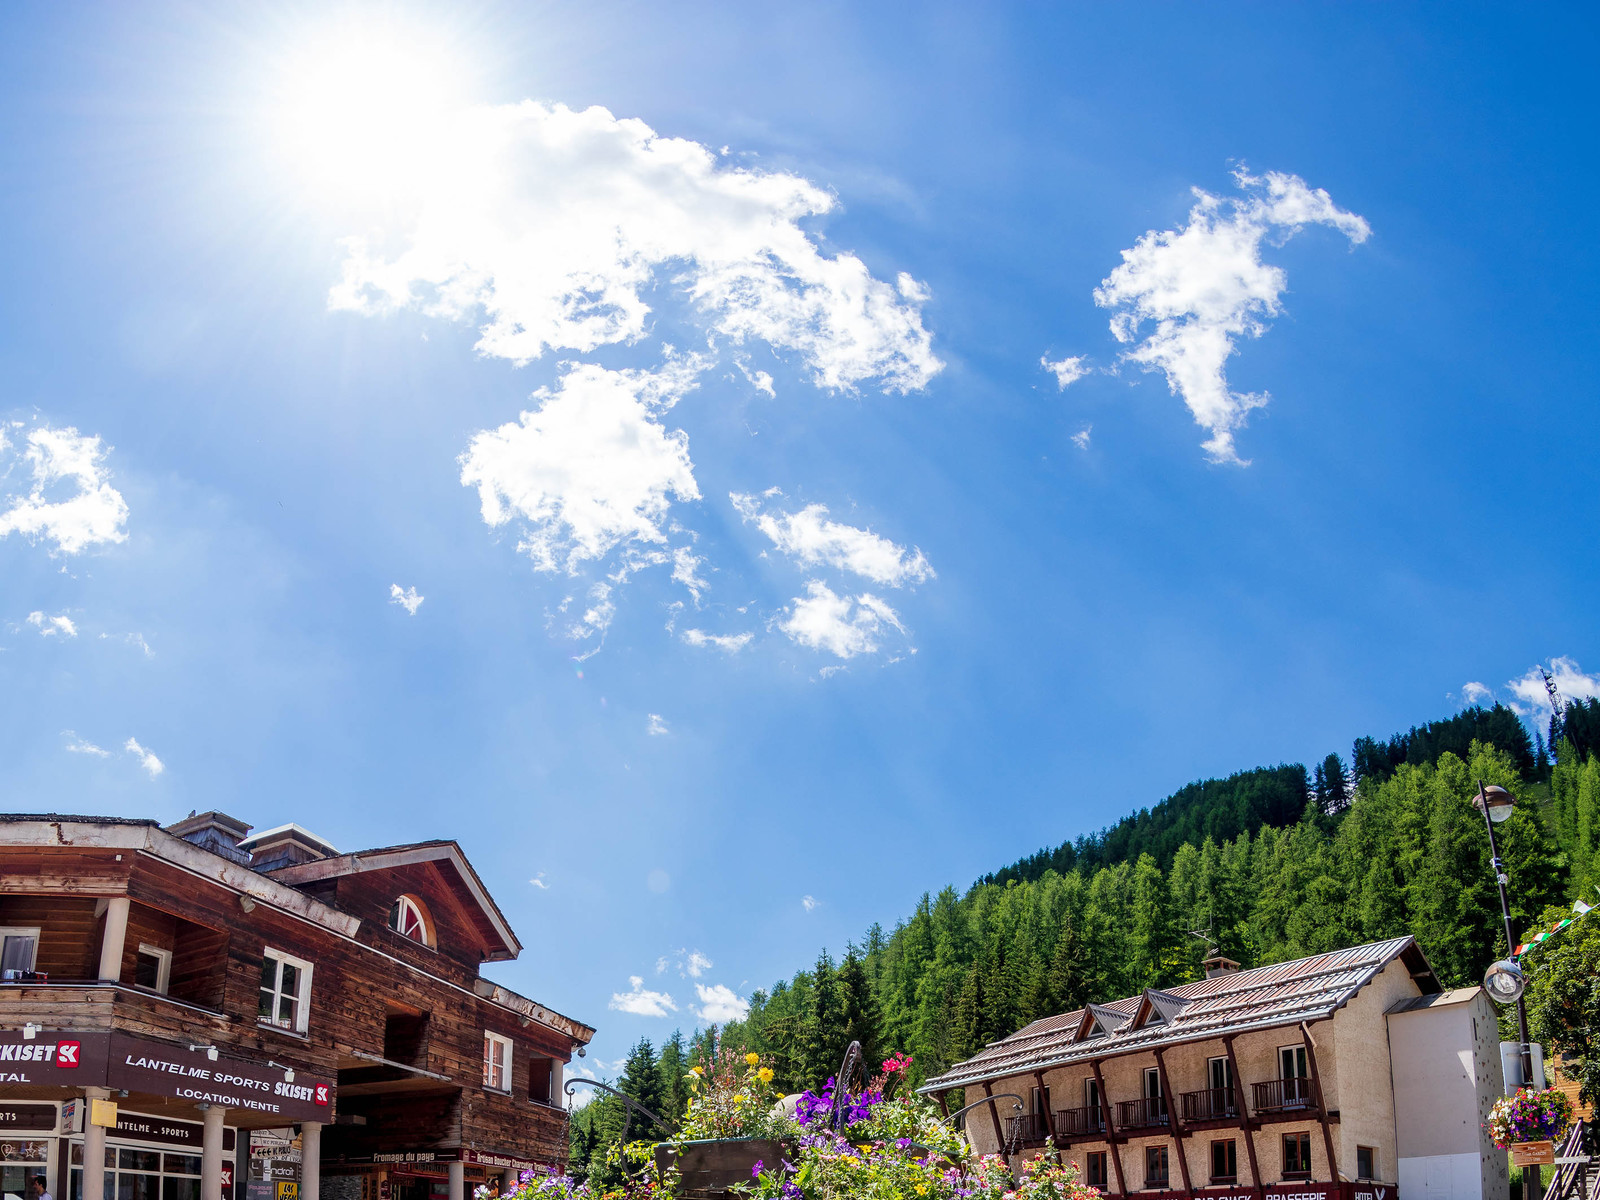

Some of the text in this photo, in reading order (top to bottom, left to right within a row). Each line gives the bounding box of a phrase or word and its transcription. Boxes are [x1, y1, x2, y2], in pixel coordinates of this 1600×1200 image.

[0, 1045, 56, 1062] KISET
[126, 1055, 210, 1080] LANTELME
[214, 1072, 270, 1092] SPORTS
[274, 1082, 314, 1102] SKISET
[176, 1088, 280, 1113] LOCATION VENTE
[118, 1122, 150, 1132] NTELME
[161, 1127, 189, 1138] SPORTS
[374, 1152, 435, 1162] Fromage du pays
[284, 1184, 294, 1193] LAS
